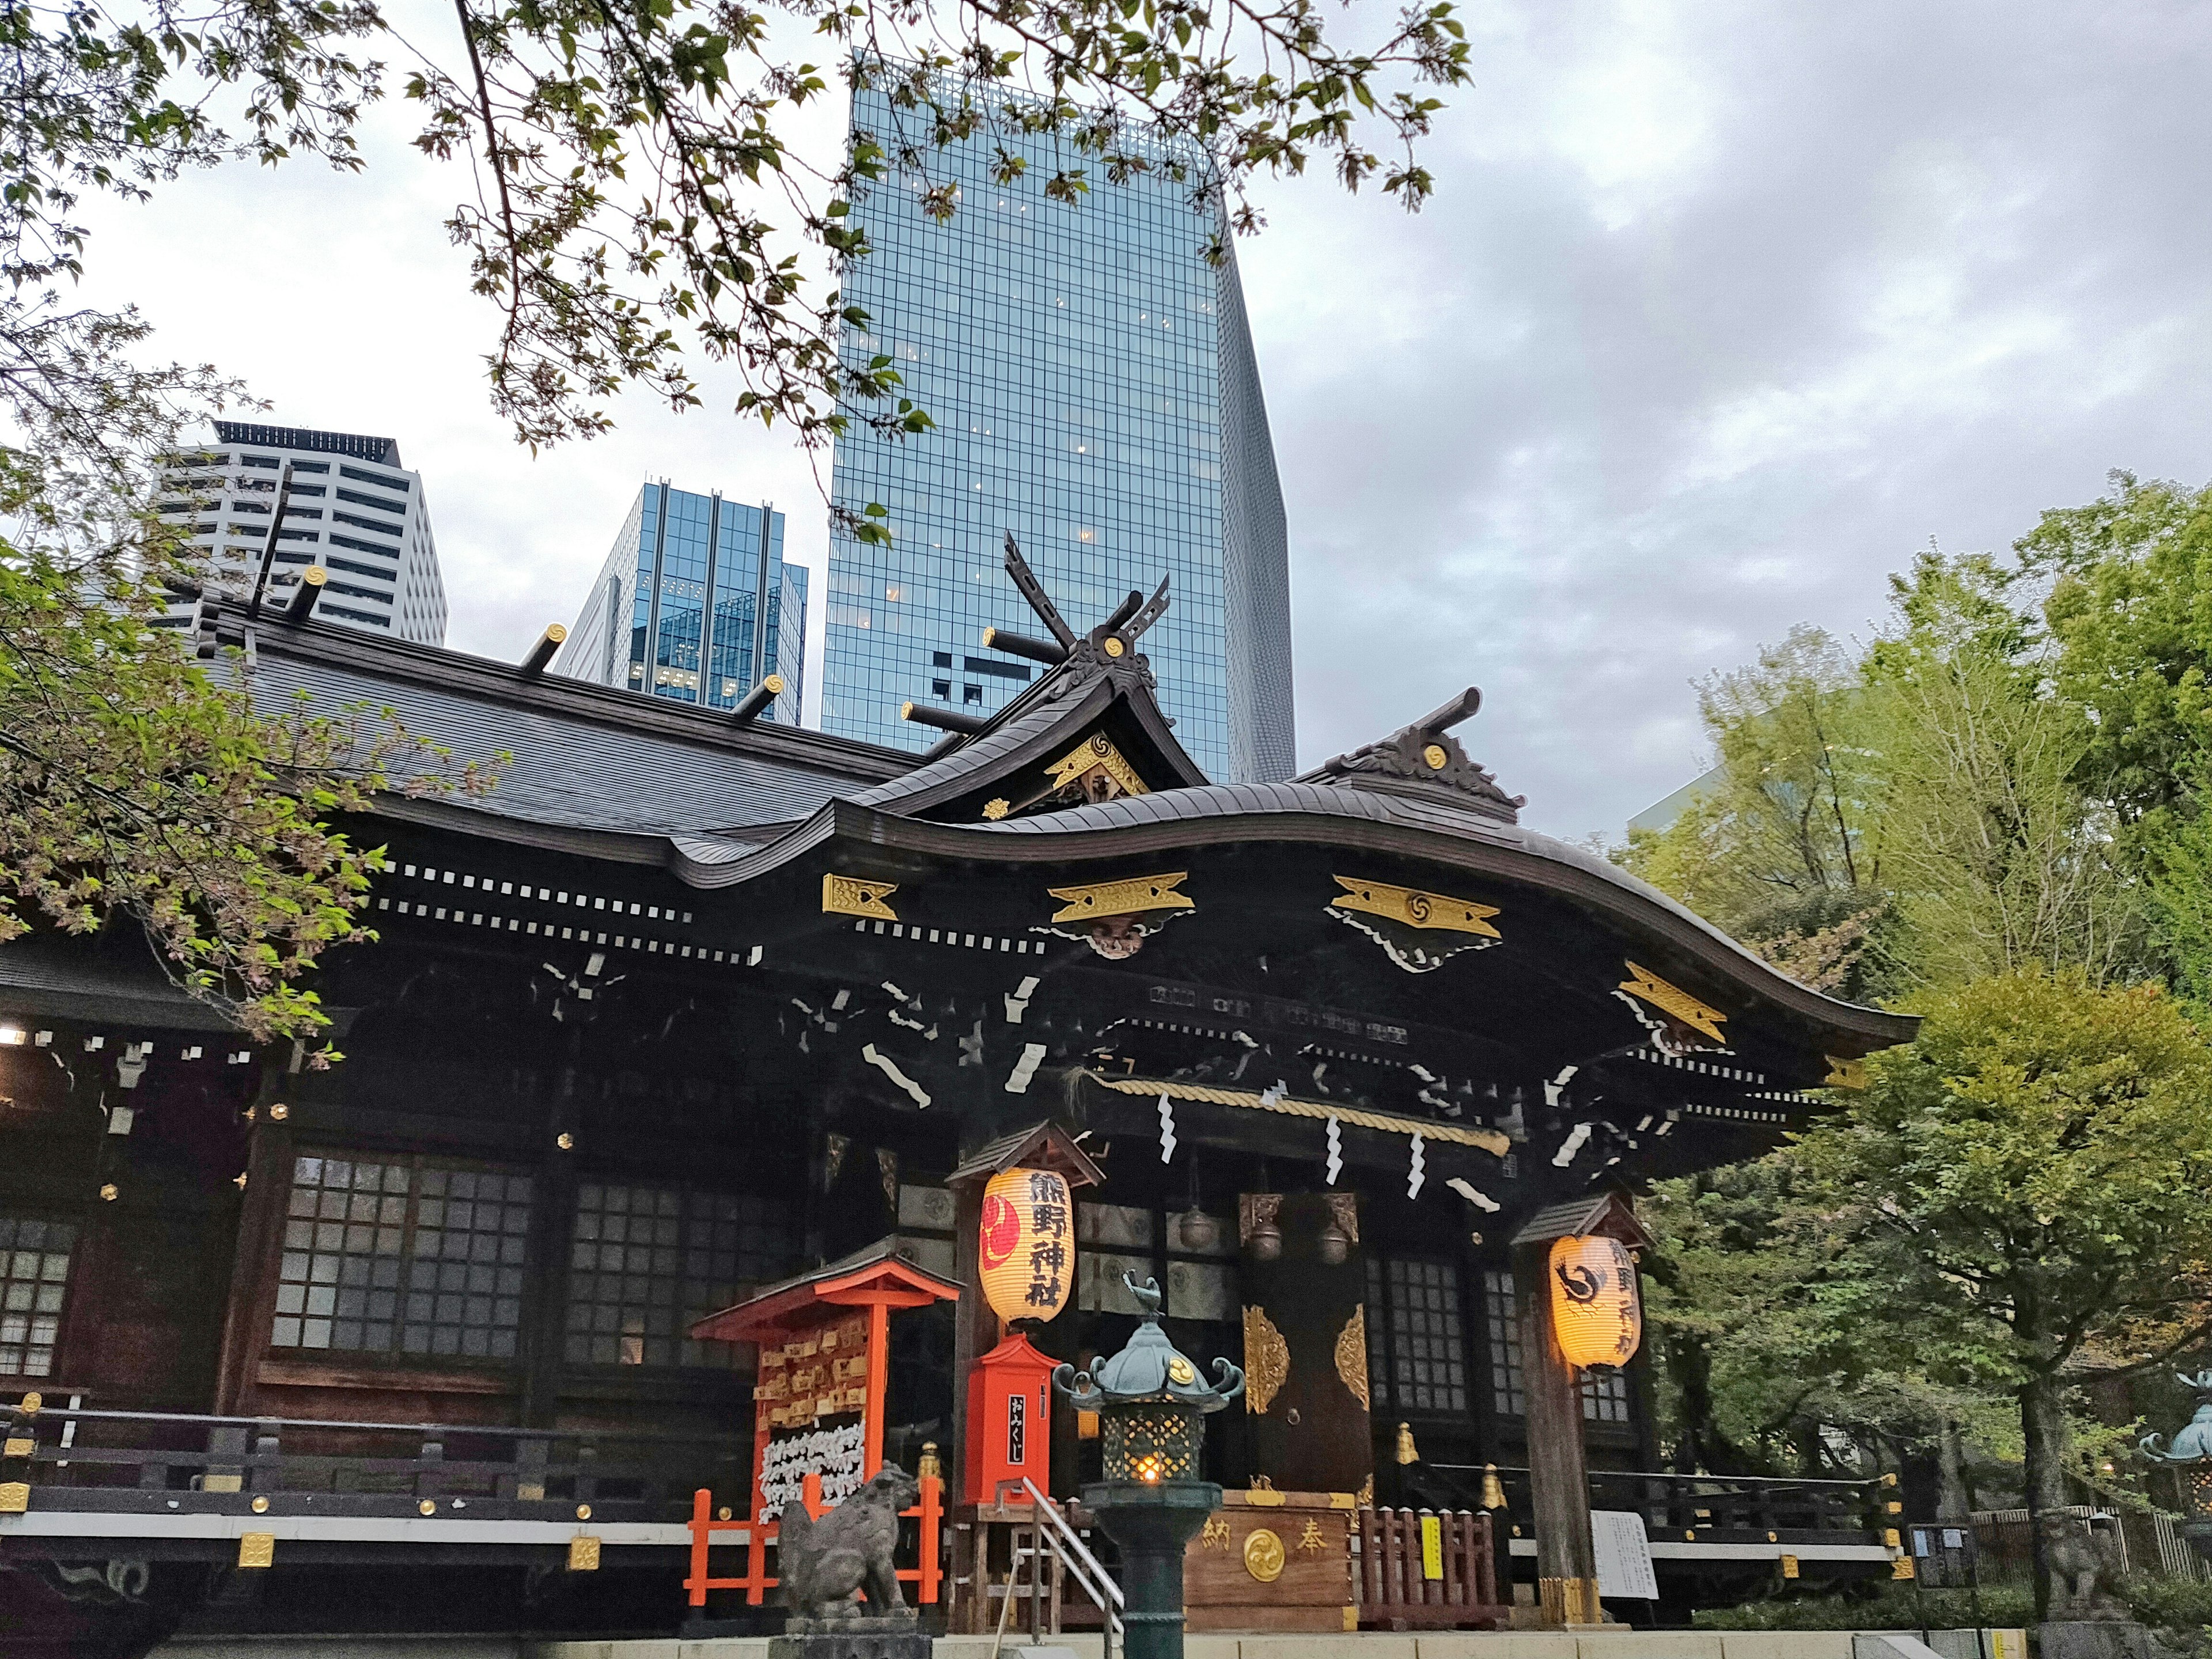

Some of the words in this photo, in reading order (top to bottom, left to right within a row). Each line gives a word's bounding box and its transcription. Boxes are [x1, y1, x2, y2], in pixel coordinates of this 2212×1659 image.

[1025, 1172, 1067, 1309] 熊野神社
[1010, 1398, 1023, 1461] おみくじ
[1202, 1517, 1230, 1551] 納
[1297, 1516, 1328, 1556] 奉
